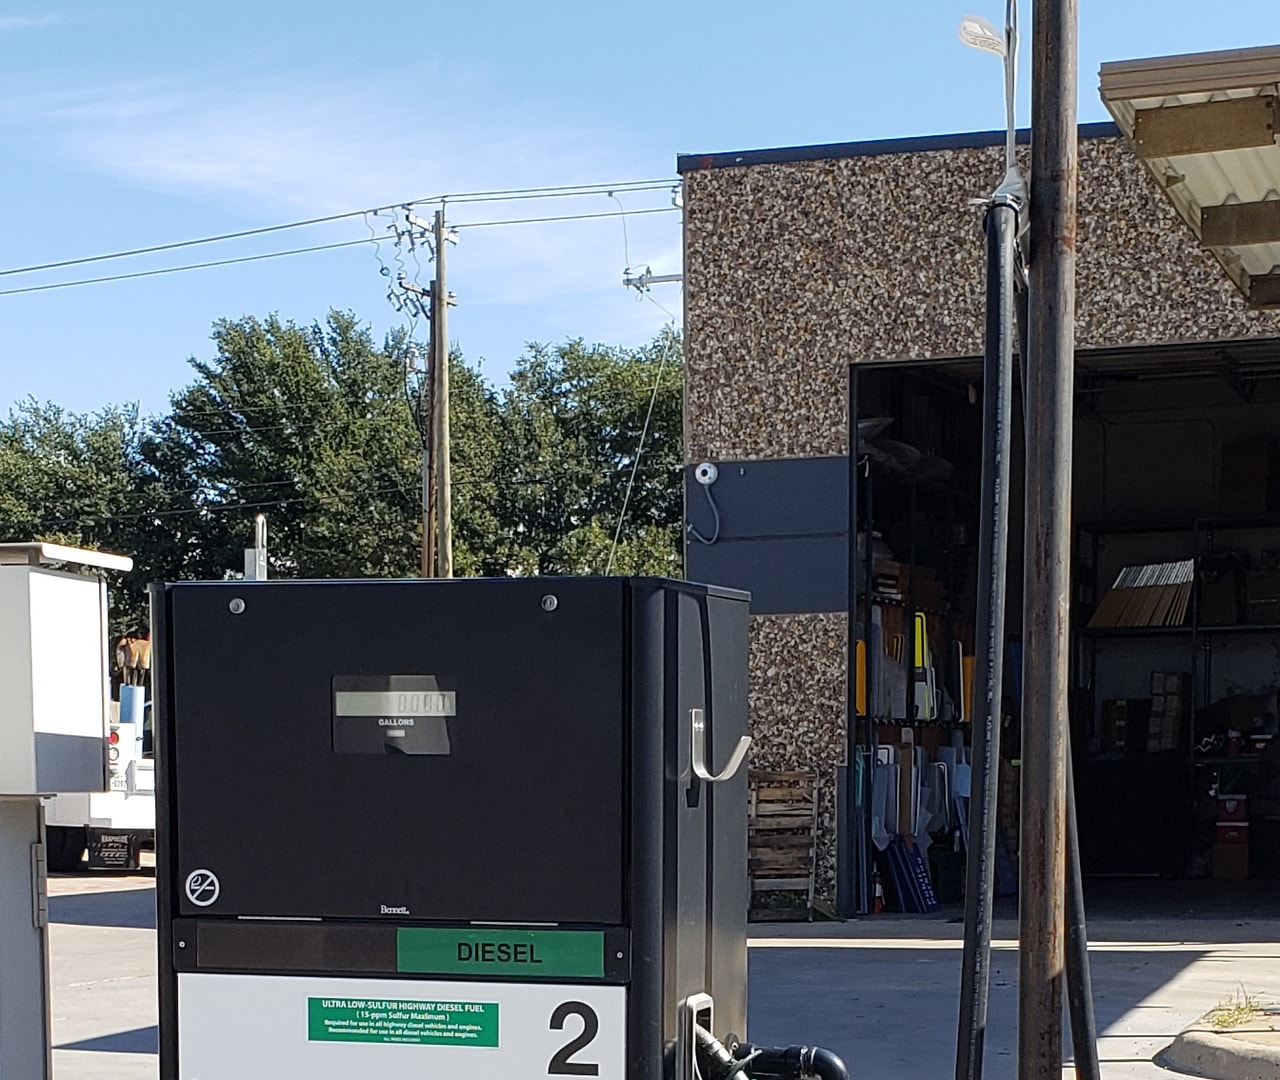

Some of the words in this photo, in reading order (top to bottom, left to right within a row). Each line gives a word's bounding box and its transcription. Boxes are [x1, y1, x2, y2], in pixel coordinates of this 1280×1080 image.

[378, 718, 414, 726] GALLONS
[457, 942, 543, 963] DIESEL
[322, 1000, 346, 1008] ULTRA
[348, 1001, 398, 1010] LOW-SULFUR
[437, 1004, 463, 1012] DIESEL
[548, 1001, 600, 1076] 2
